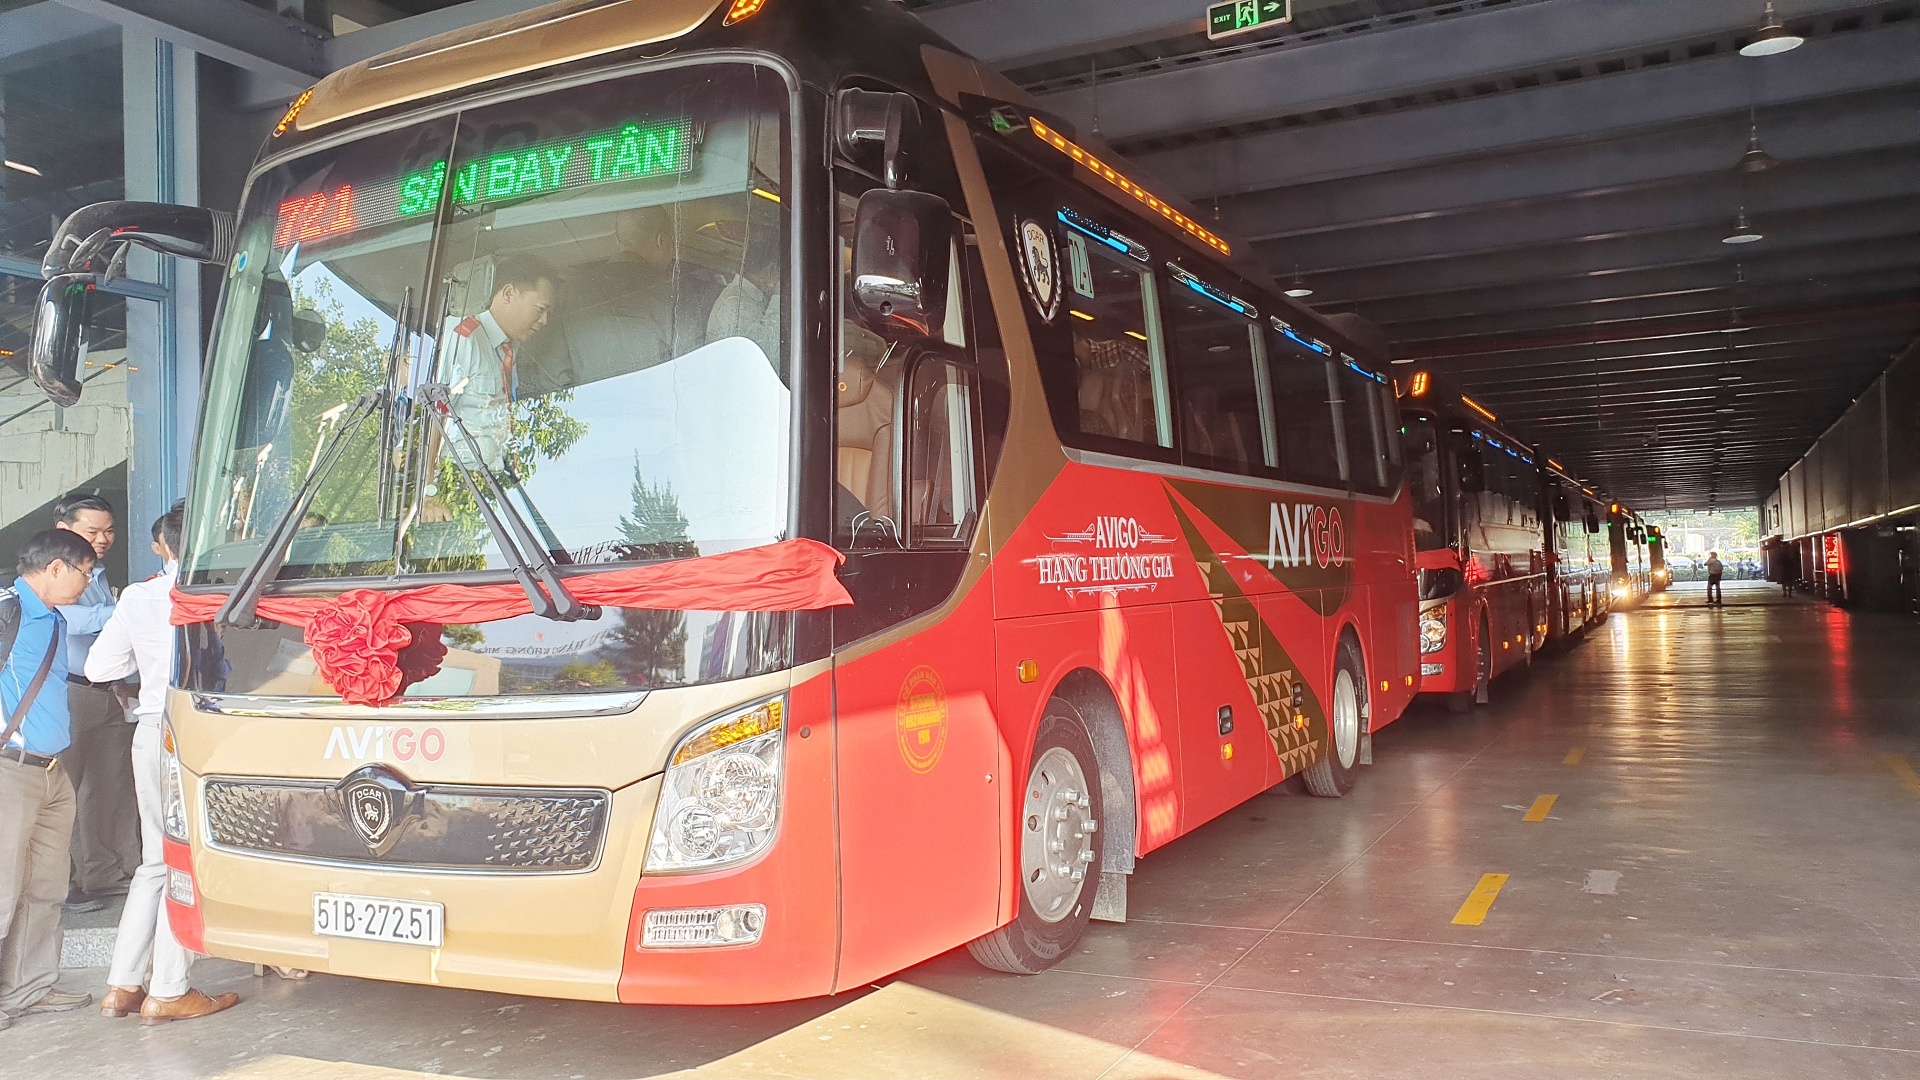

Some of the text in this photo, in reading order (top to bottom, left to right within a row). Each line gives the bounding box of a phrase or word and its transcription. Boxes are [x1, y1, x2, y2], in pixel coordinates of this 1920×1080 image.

[1213, 14, 1231, 24] EXIT
[399, 123, 676, 215] SÂN BAY TÂN
[1095, 516, 1138, 549] AVIGO
[1152, 555, 1175, 579] GIA
[323, 726, 446, 762] AVIGO
[356, 788, 382, 799] DCAR
[318, 898, 433, 941] 51B-272.51
